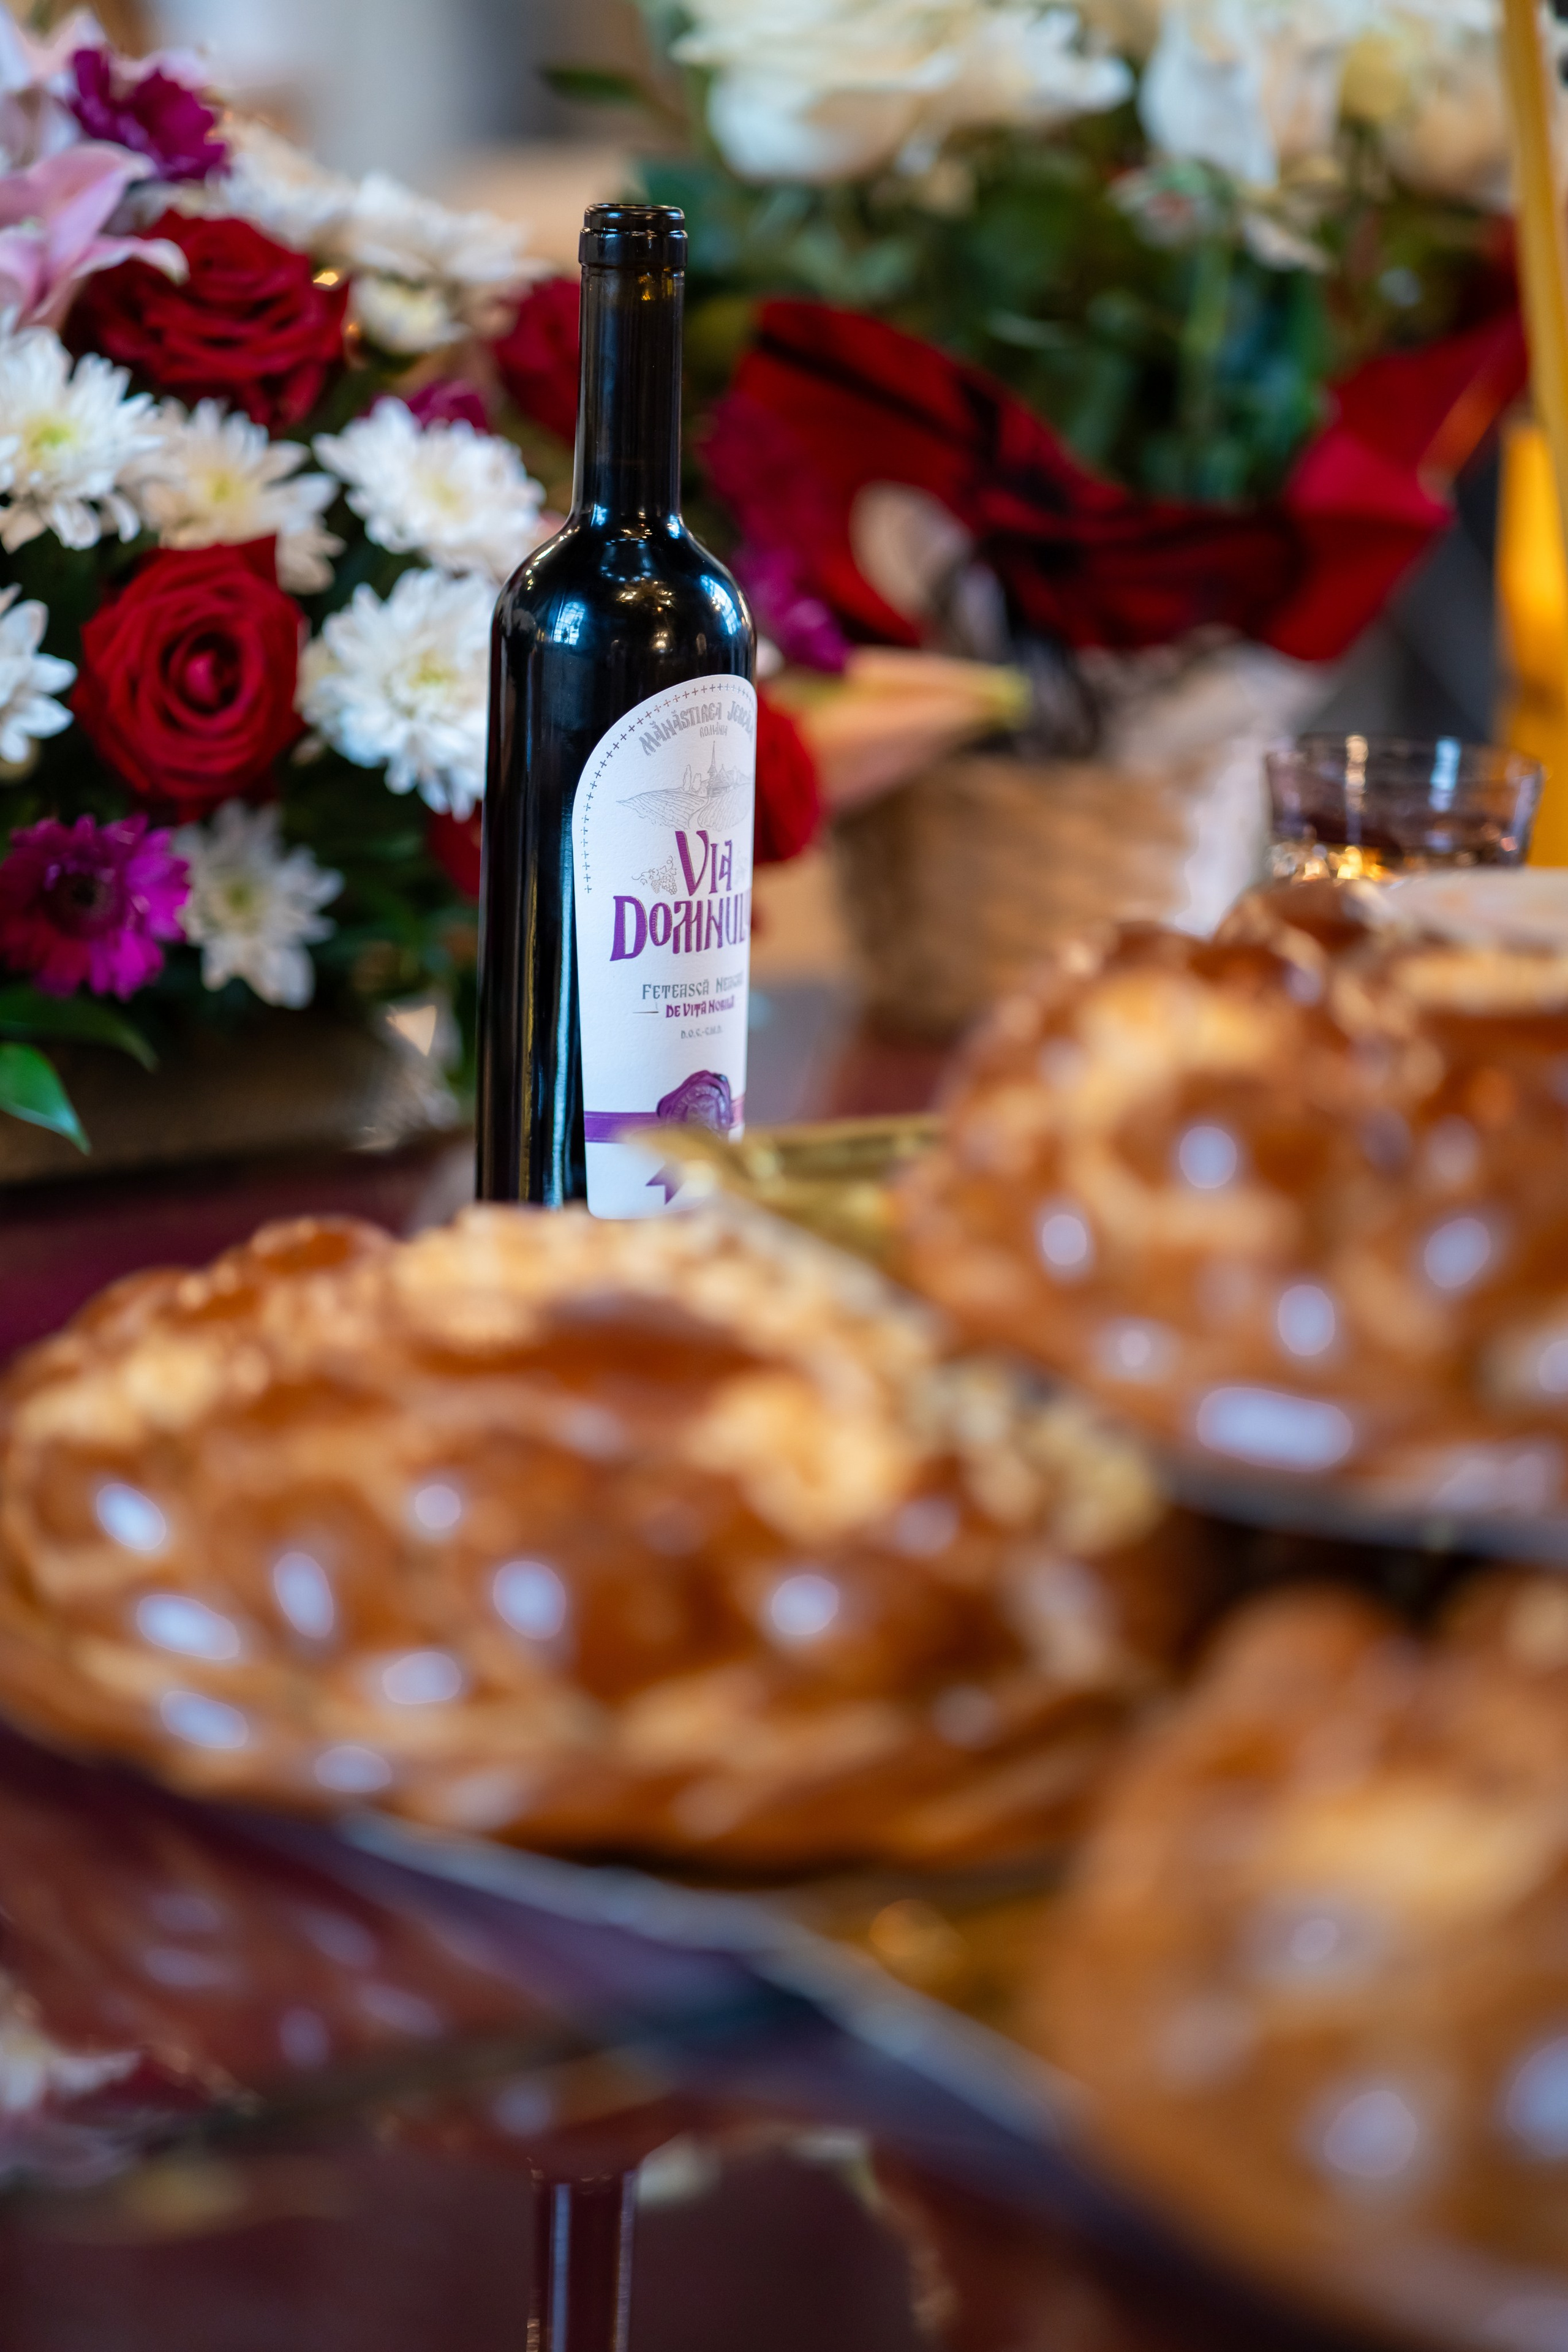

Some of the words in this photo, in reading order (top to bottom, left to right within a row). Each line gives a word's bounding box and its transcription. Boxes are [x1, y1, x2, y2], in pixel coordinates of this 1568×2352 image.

[675, 830, 732, 896] VIA
[609, 891, 748, 961] DOMNUL
[642, 979, 710, 1000] FETEASCĂ
[665, 1004, 680, 1018] DE
